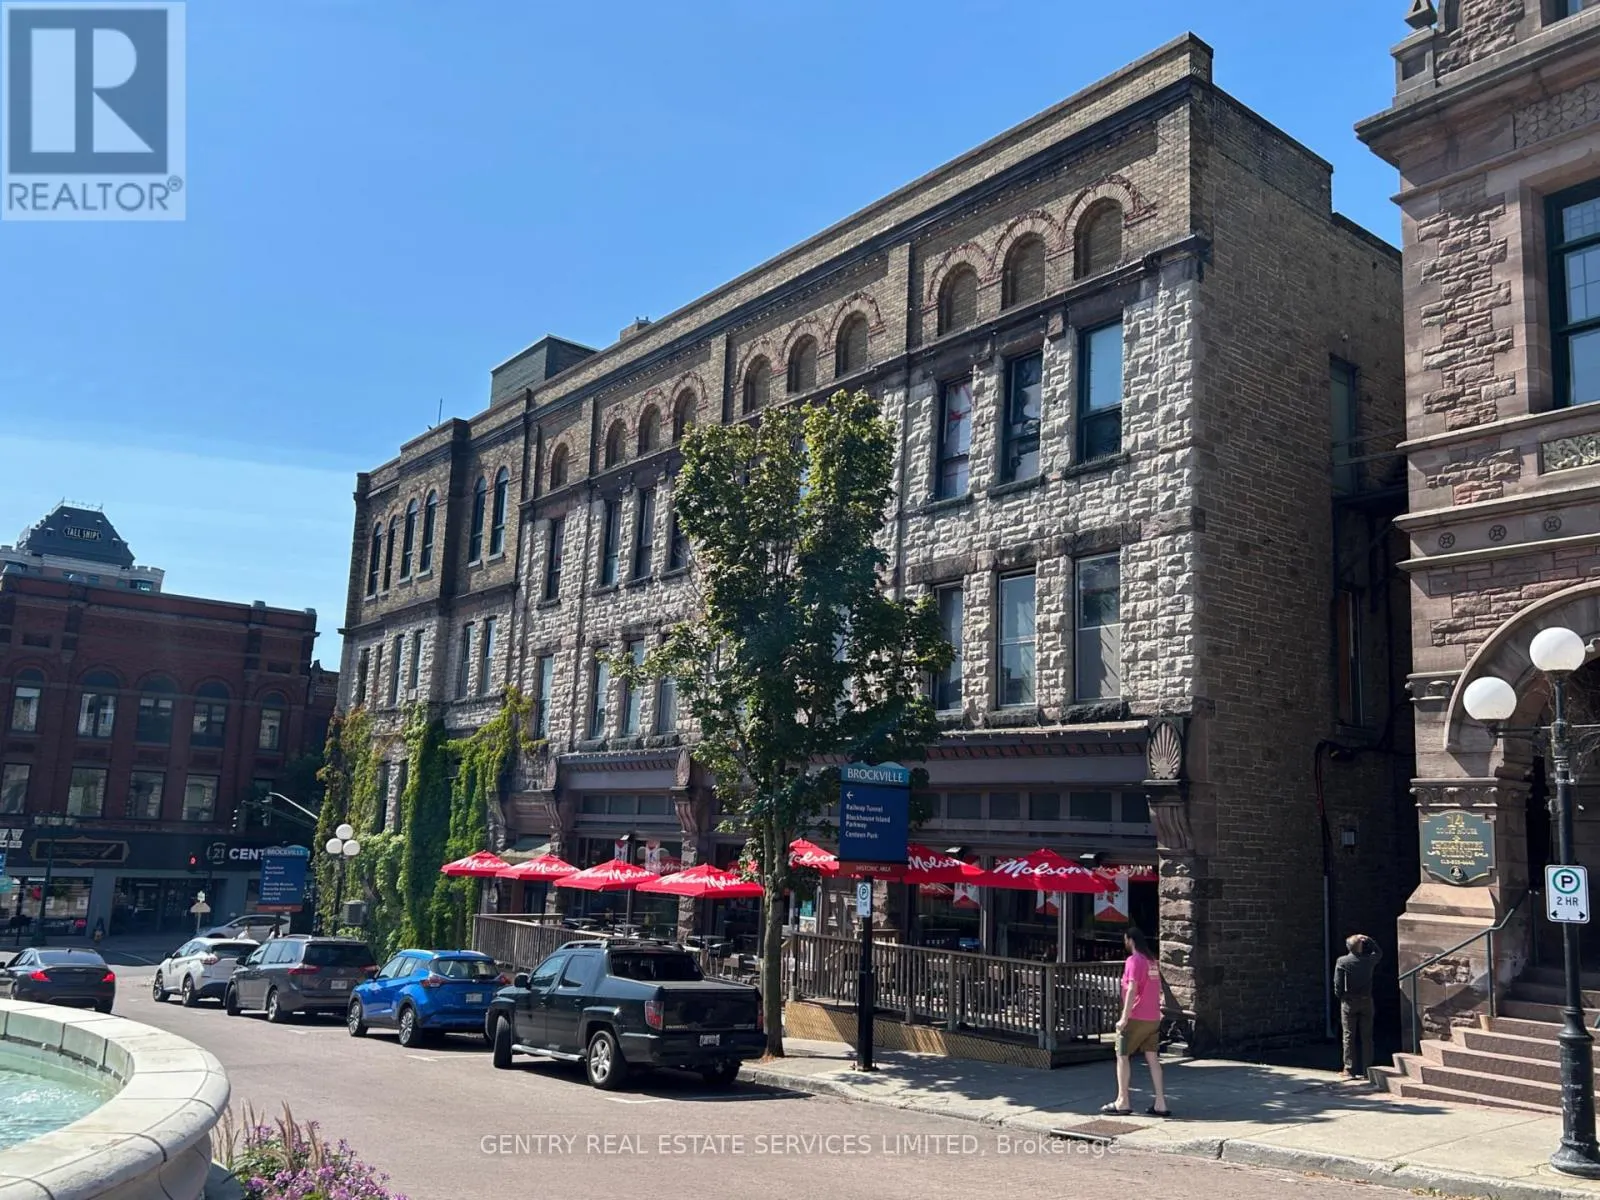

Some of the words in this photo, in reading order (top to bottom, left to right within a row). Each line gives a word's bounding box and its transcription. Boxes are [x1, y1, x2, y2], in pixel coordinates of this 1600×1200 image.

[847, 768, 904, 782] BROCKVILLE
[846, 804, 866, 812] Railway
[846, 814, 874, 822] Blockhouse
[846, 821, 867, 829] Parkway
[528, 860, 580, 873] Molson
[908, 856, 960, 873] Molson
[992, 860, 1082, 878] Molson
[1561, 875, 1574, 888] P
[1557, 896, 1563, 906] 2
[1565, 896, 1579, 907] HR
